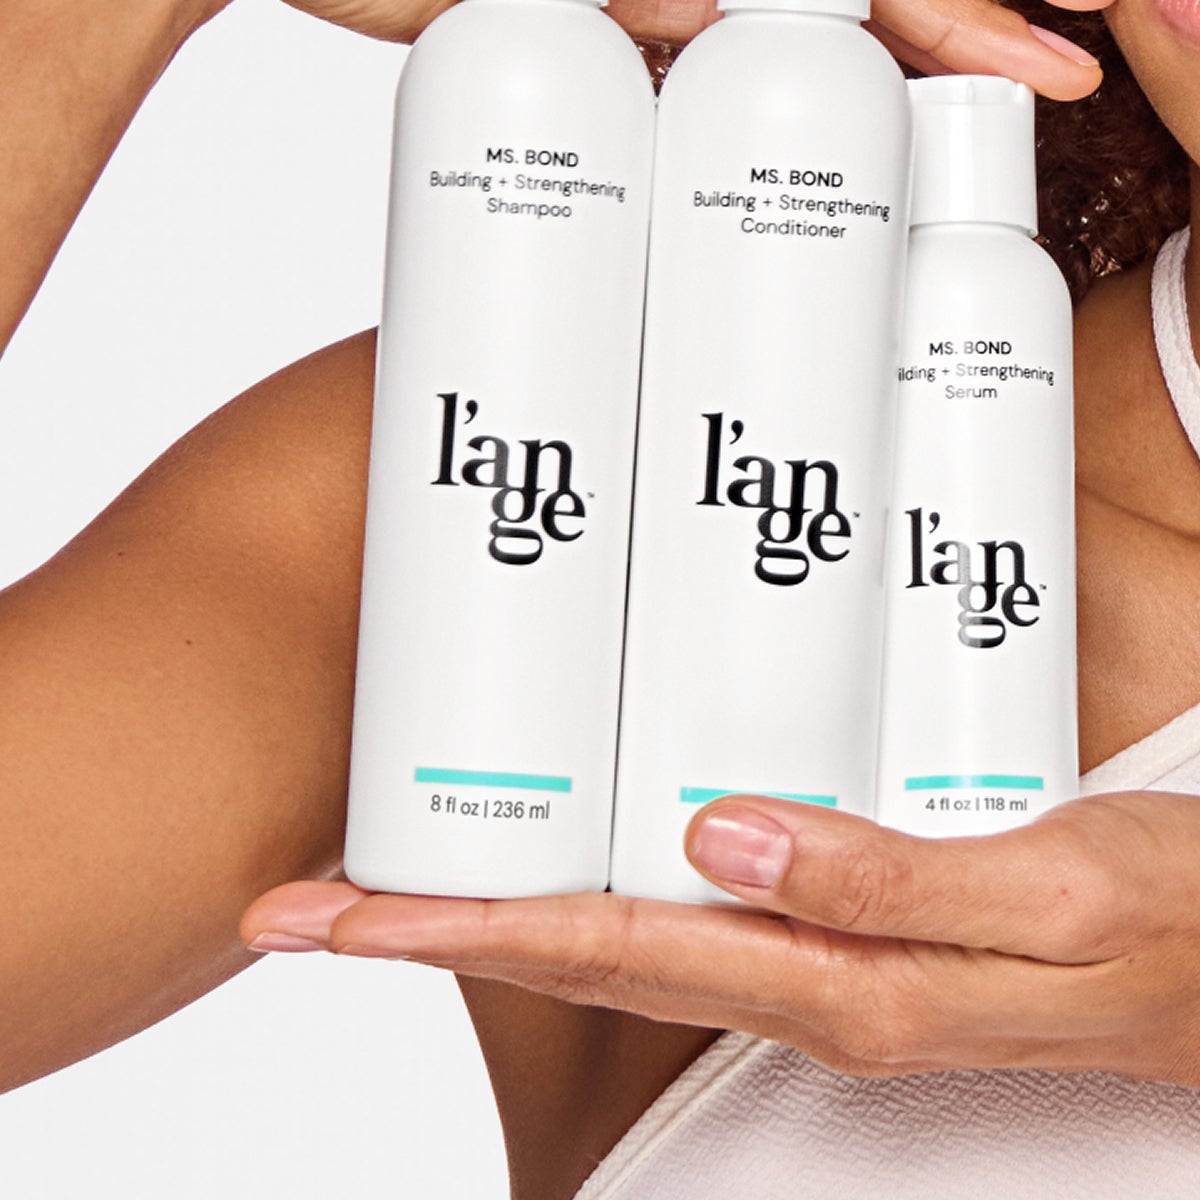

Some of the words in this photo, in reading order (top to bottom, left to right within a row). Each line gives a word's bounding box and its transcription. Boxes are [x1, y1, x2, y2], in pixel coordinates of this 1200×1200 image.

[486, 147, 519, 164] MS.
[525, 149, 579, 168] BOND
[430, 170, 492, 192] Building
[498, 177, 508, 187] +
[514, 173, 626, 203] Strengthening
[750, 167, 783, 184] MS.
[789, 169, 843, 188] BOND
[487, 197, 572, 219] Shampoo
[693, 190, 756, 212] Building
[762, 197, 772, 207] +
[779, 194, 890, 222] Strengthening
[741, 217, 846, 238] Conditioner
[929, 341, 958, 356] MS.
[964, 341, 1012, 355] BOND
[941, 367, 950, 376] +
[955, 363, 1054, 386] Strengthening
[945, 385, 998, 399] Serum
[430, 794, 441, 812] 8
[446, 796, 456, 814] fl
[460, 802, 480, 816] oz
[493, 800, 525, 819] 236
[529, 800, 550, 819] ml
[925, 798, 935, 811] 4
[940, 797, 950, 811] fl
[953, 800, 972, 811] oz
[984, 797, 1005, 811] 118
[1009, 798, 1027, 811] ml
